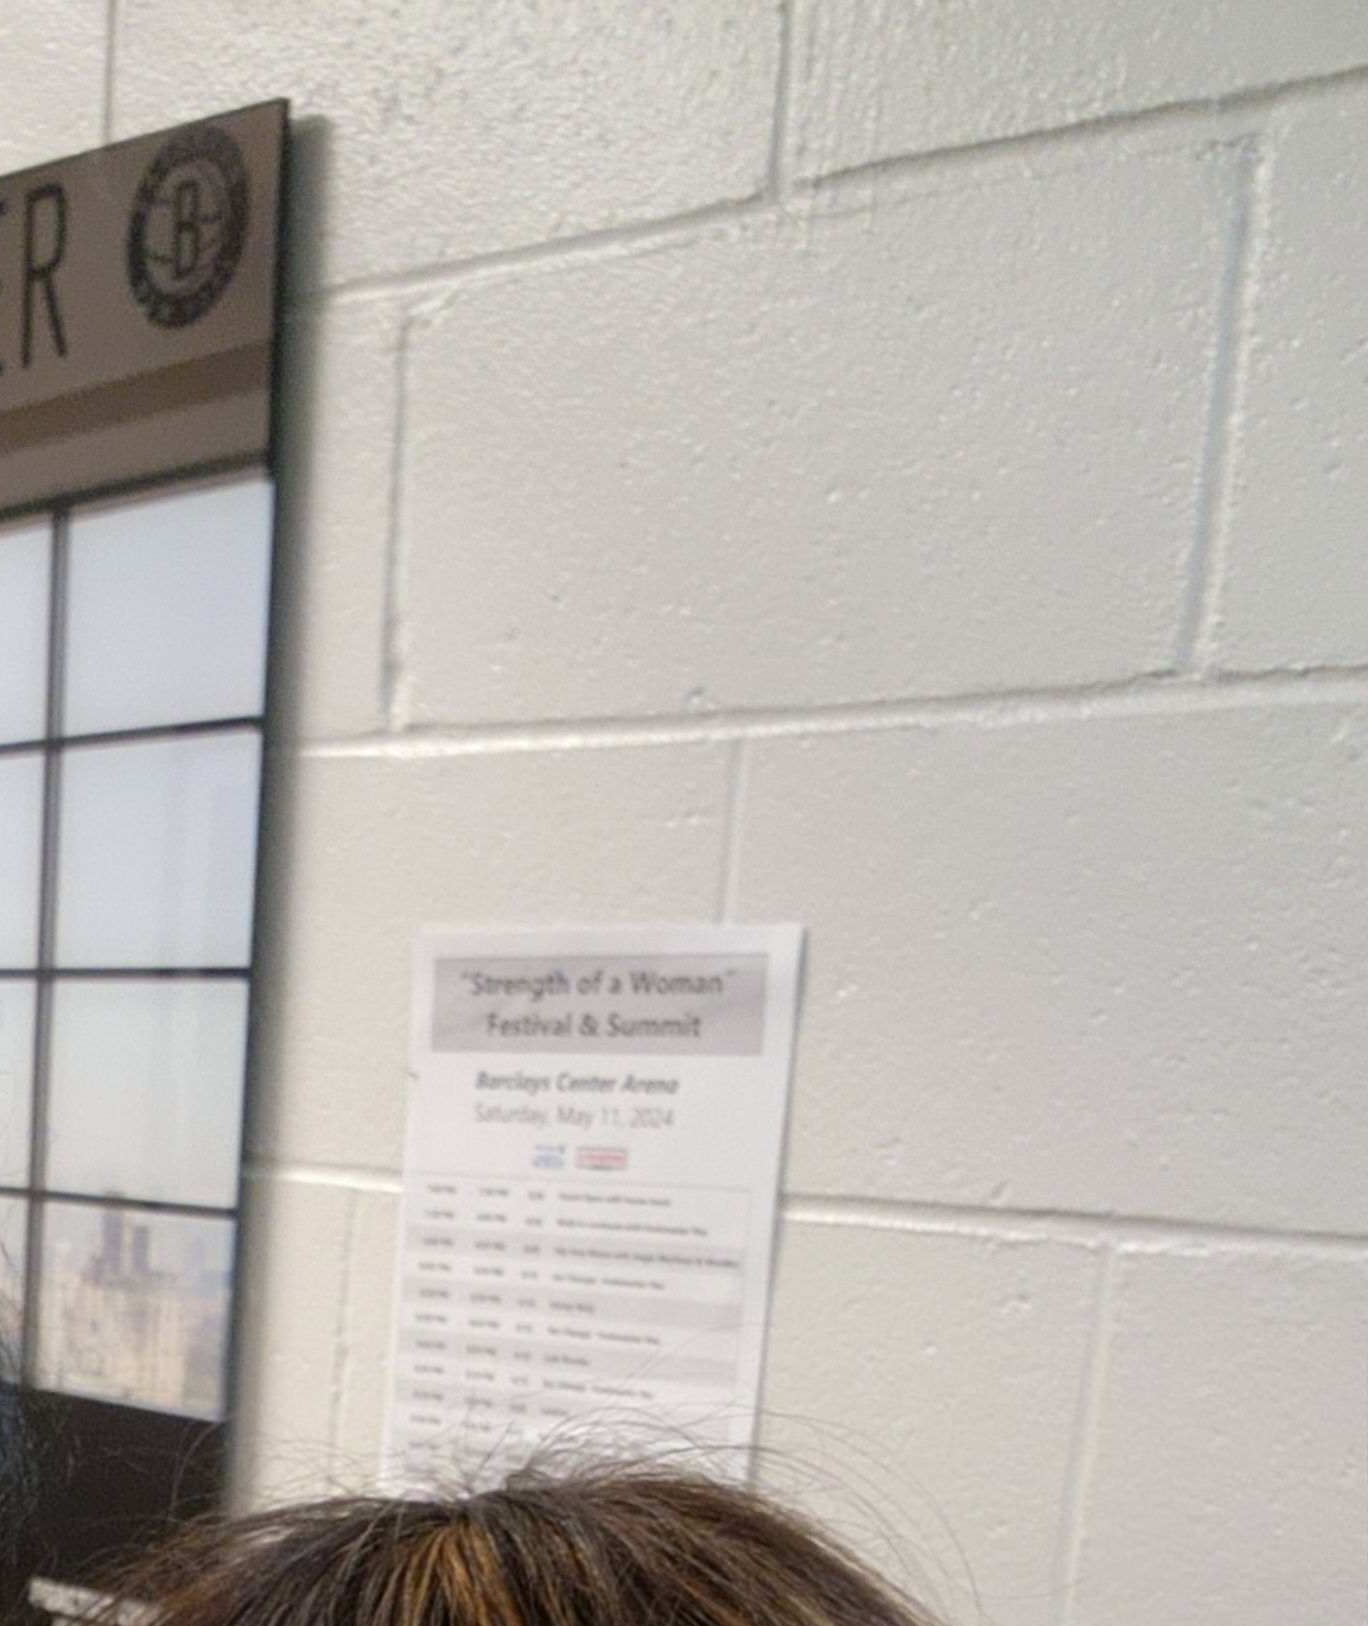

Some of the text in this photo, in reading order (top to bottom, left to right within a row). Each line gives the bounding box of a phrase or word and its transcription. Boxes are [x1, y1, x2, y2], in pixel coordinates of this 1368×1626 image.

[173, 178, 202, 281] B
[577, 968, 604, 996] of
[608, 975, 623, 996] a
[487, 1012, 702, 1039] Festival & Summit
[475, 1070, 680, 1097] Barclays Center Arena
[557, 1105, 593, 1131] May
[630, 1106, 675, 1129] 2024
